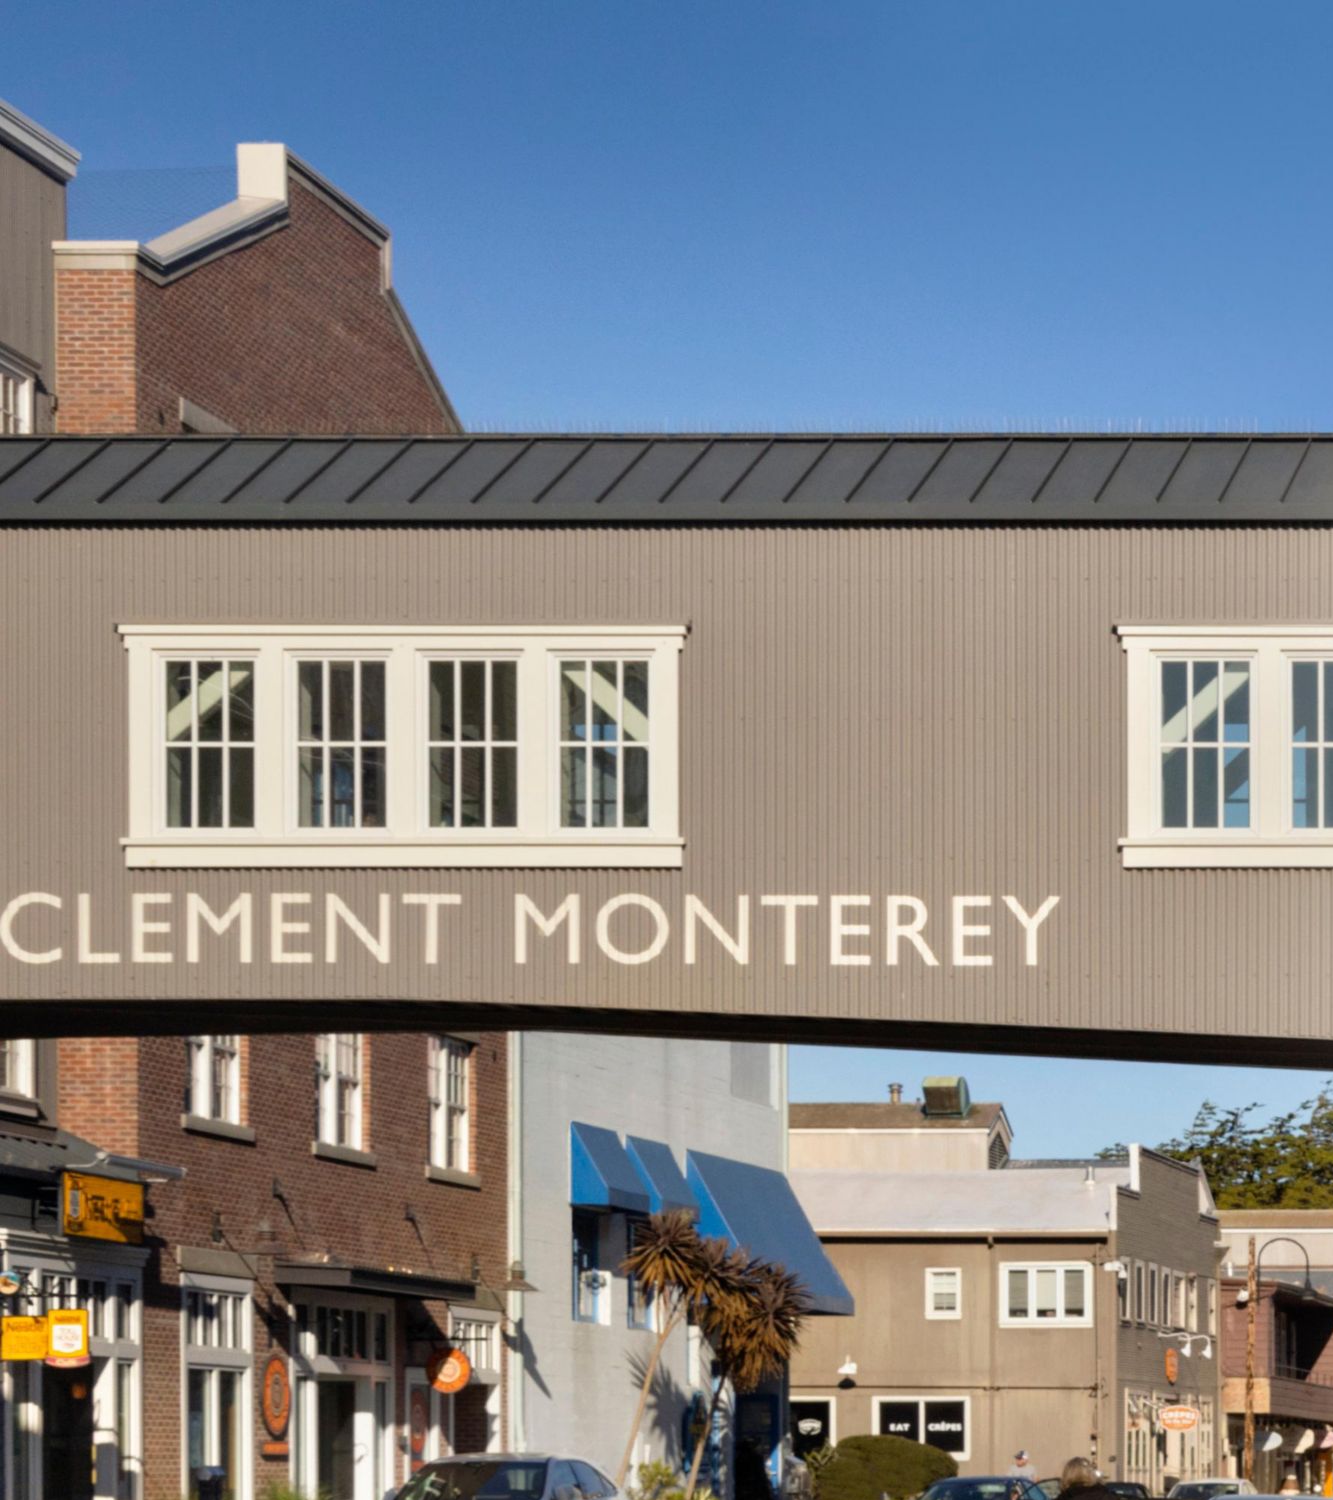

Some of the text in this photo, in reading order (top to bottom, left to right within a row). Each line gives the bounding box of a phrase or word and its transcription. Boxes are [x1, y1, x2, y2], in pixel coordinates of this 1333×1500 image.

[0, 892, 1061, 966] CLEMENT MONTEREY
[889, 1422, 910, 1432] EAT
